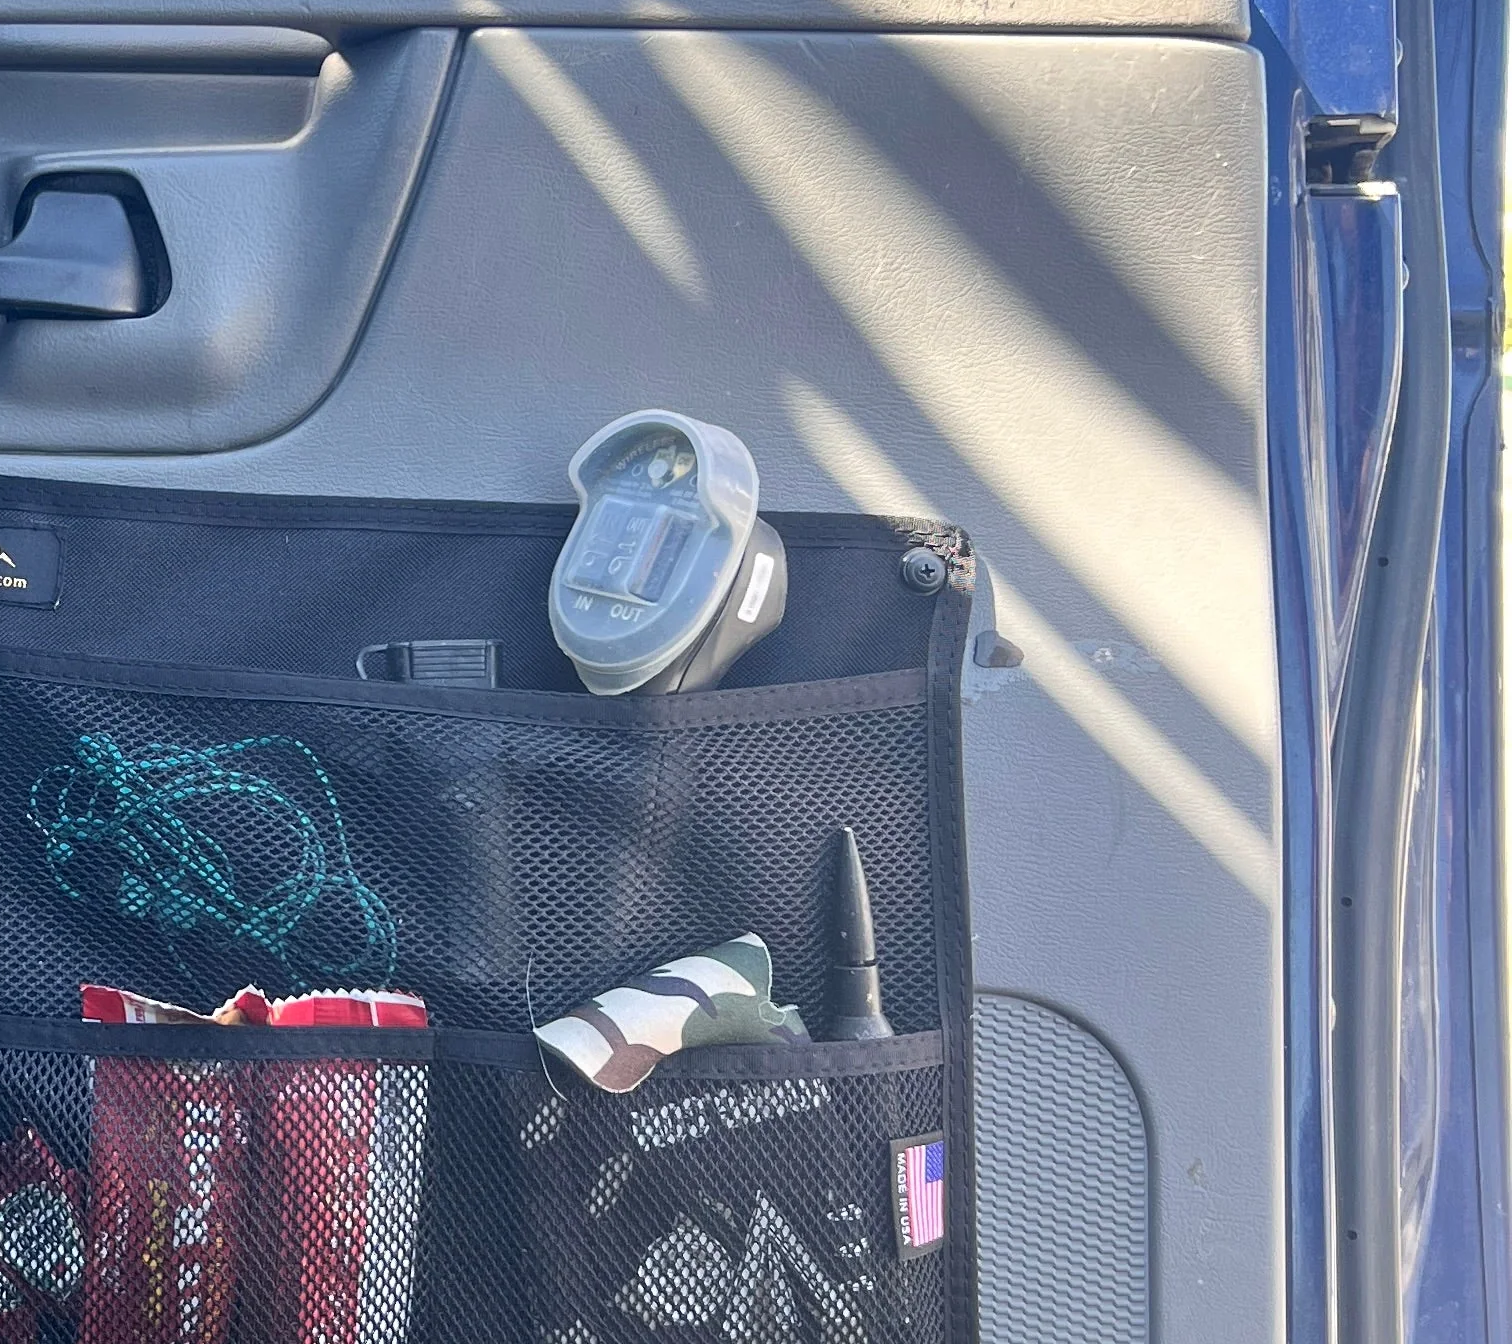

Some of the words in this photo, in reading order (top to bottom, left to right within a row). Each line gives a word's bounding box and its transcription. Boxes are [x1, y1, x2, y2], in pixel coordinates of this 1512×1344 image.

[573, 594, 594, 611] IN
[610, 603, 646, 623] OUT
[896, 1152, 908, 1194] MADE
[898, 1197, 909, 1213] IN
[900, 1215, 912, 1246] USA
